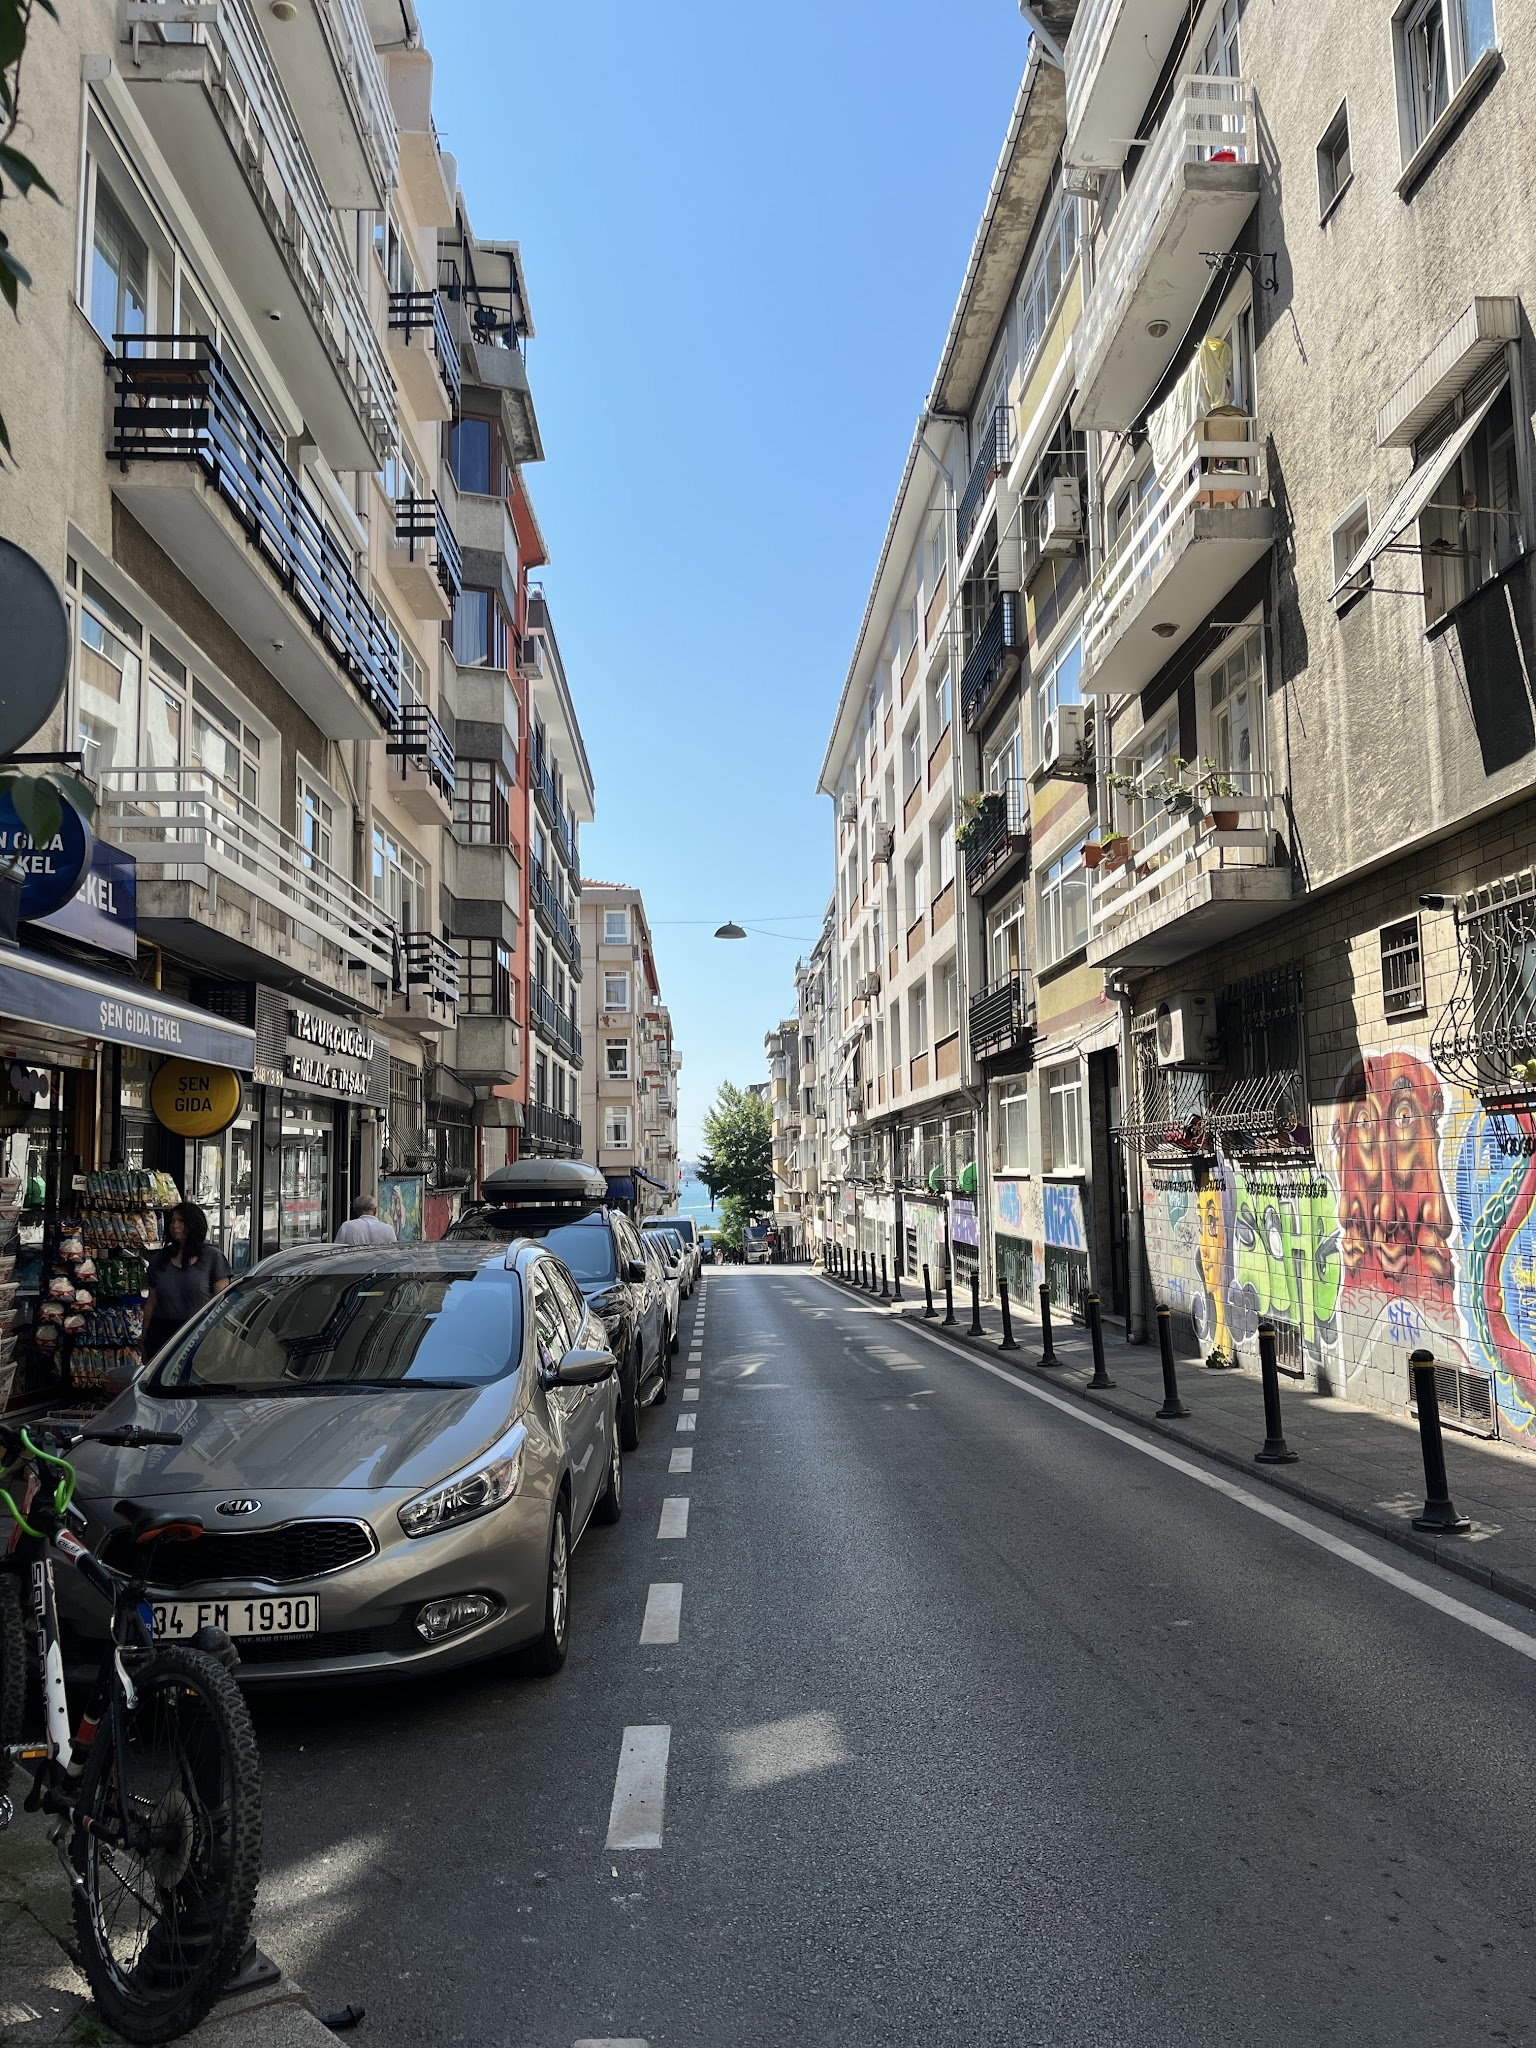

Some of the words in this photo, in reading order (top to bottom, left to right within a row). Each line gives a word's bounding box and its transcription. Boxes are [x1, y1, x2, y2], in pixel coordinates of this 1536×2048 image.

[0, 854, 56, 874] KEL
[100, 1000, 123, 1031] ŞEN
[125, 1008, 150, 1037] GIDA
[151, 1015, 182, 1044] TEKEL
[178, 1076, 210, 1095] ŞEN
[174, 1097, 212, 1112] GIDA
[222, 1500, 253, 1512] KIA
[153, 1605, 184, 1636] 34
[244, 1599, 310, 1632] 1930
